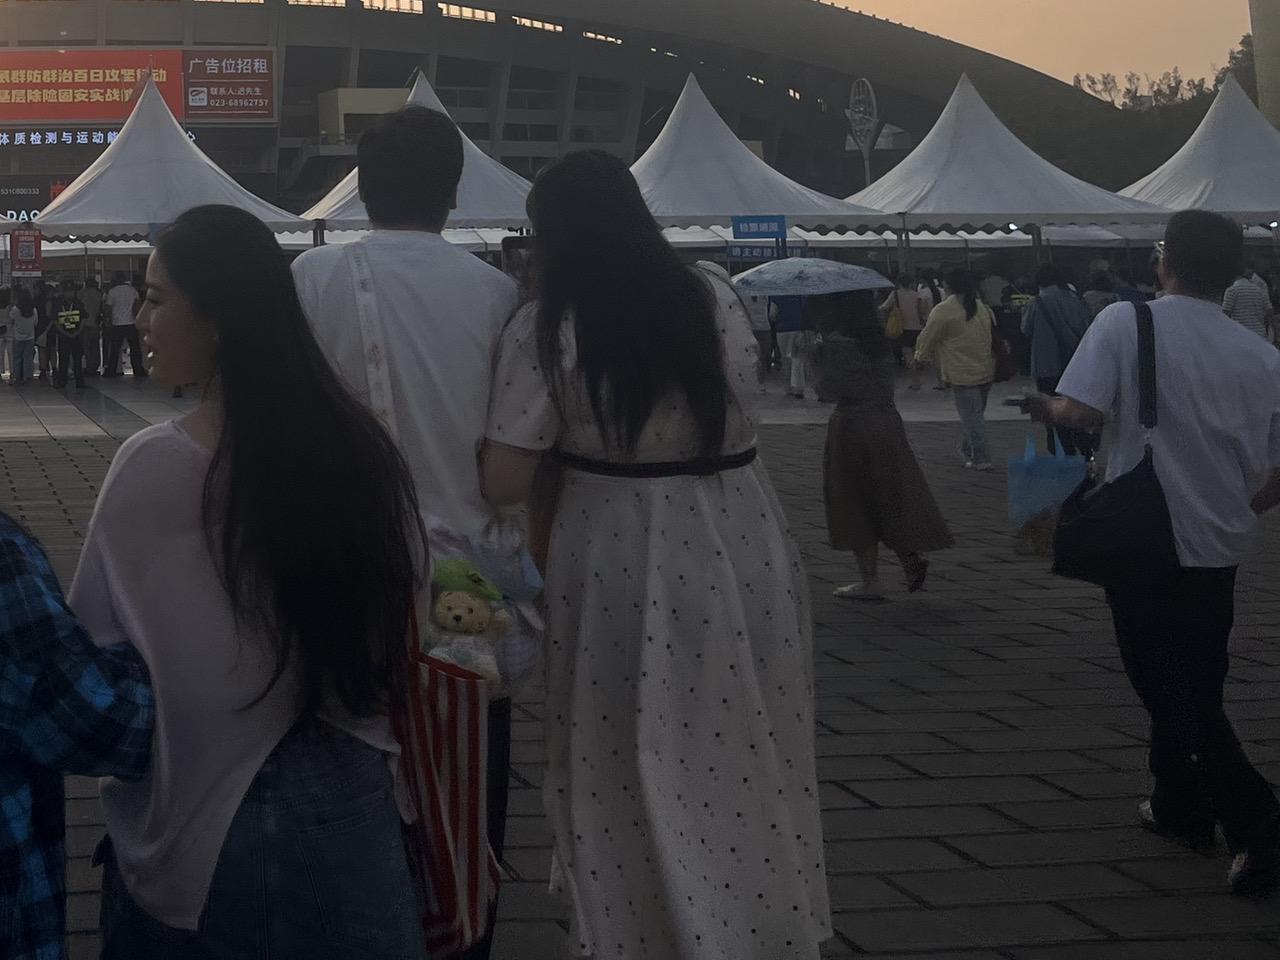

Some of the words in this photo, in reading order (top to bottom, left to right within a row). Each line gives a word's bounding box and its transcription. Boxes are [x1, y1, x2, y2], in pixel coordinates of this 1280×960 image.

[189, 58, 269, 73] 广告位招租
